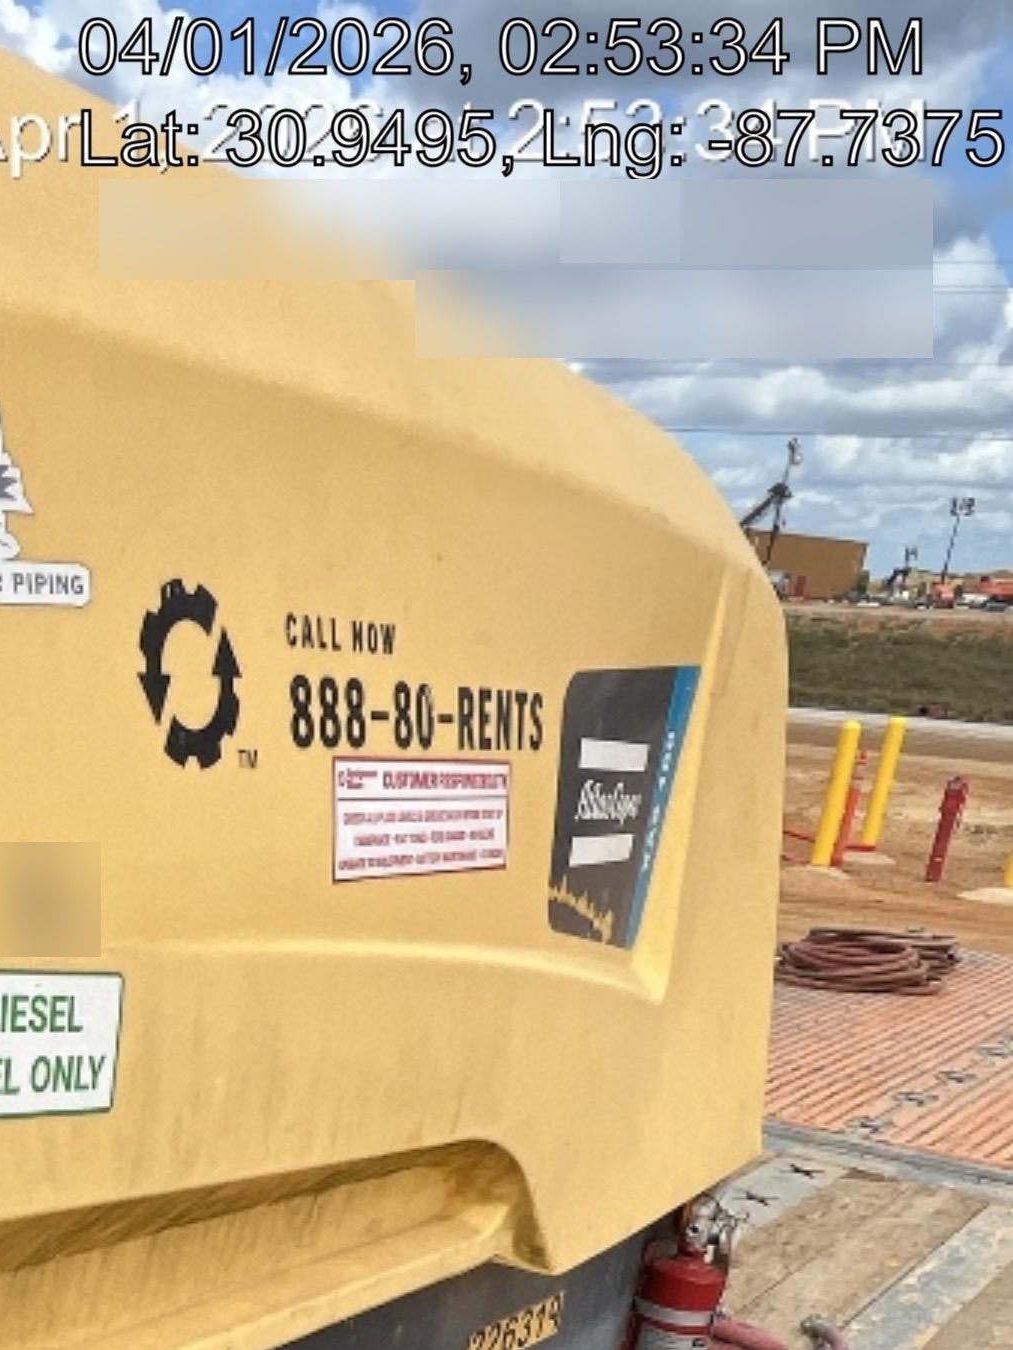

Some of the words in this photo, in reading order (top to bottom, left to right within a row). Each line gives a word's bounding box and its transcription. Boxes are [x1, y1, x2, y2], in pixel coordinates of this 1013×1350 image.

[13, 572, 84, 595] PIPING
[285, 612, 341, 651] CALL
[351, 620, 396, 655] NOW
[290, 674, 544, 751] 888-80-RENTS
[31, 1055, 106, 1093] ONLY
